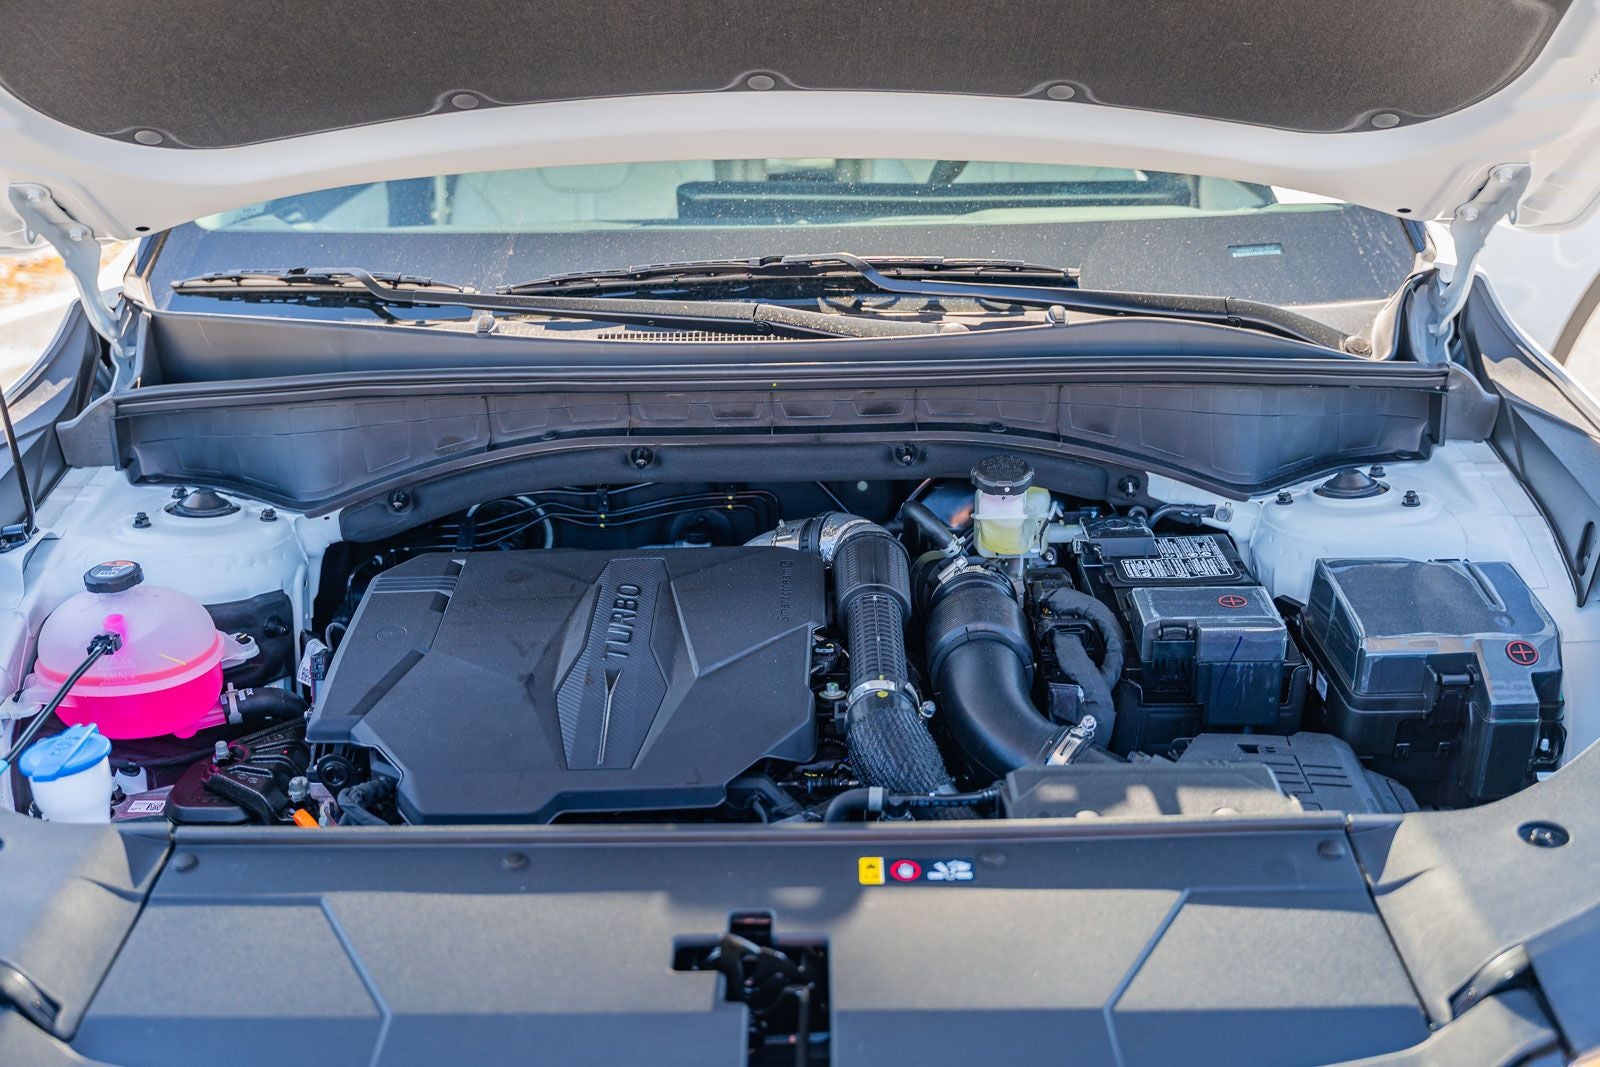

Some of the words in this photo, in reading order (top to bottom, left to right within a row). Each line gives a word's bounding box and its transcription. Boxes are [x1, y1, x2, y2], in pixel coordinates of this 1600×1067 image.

[601, 583, 641, 661] TURBO
[97, 655, 128, 667] MAX
[103, 670, 128, 682] MIN
